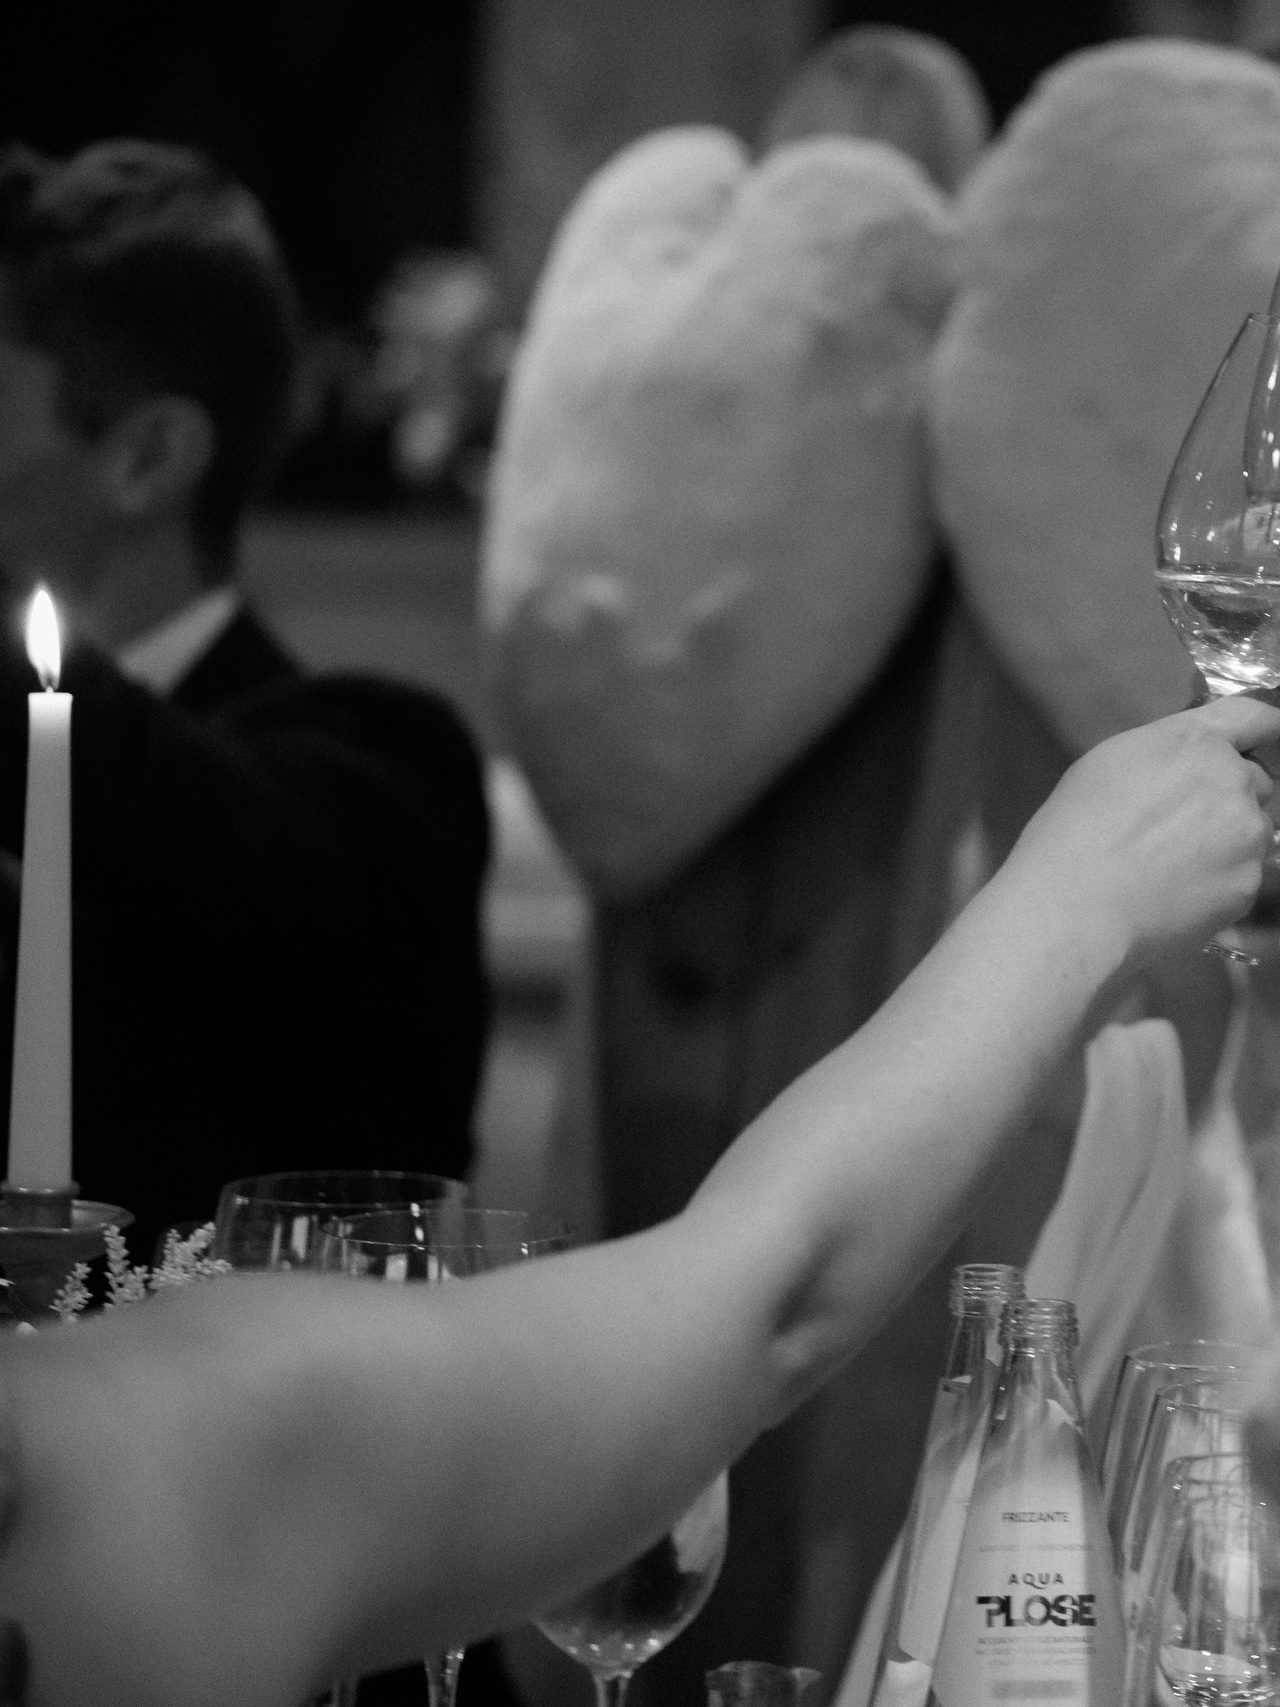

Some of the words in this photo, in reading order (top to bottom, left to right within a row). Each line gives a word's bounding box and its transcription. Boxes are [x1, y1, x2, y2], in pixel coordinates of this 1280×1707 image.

[1002, 1511, 1070, 1523] FRIZZANTE
[1008, 1572, 1065, 1590] AQUA
[976, 1594, 1096, 1628] PLOSE
